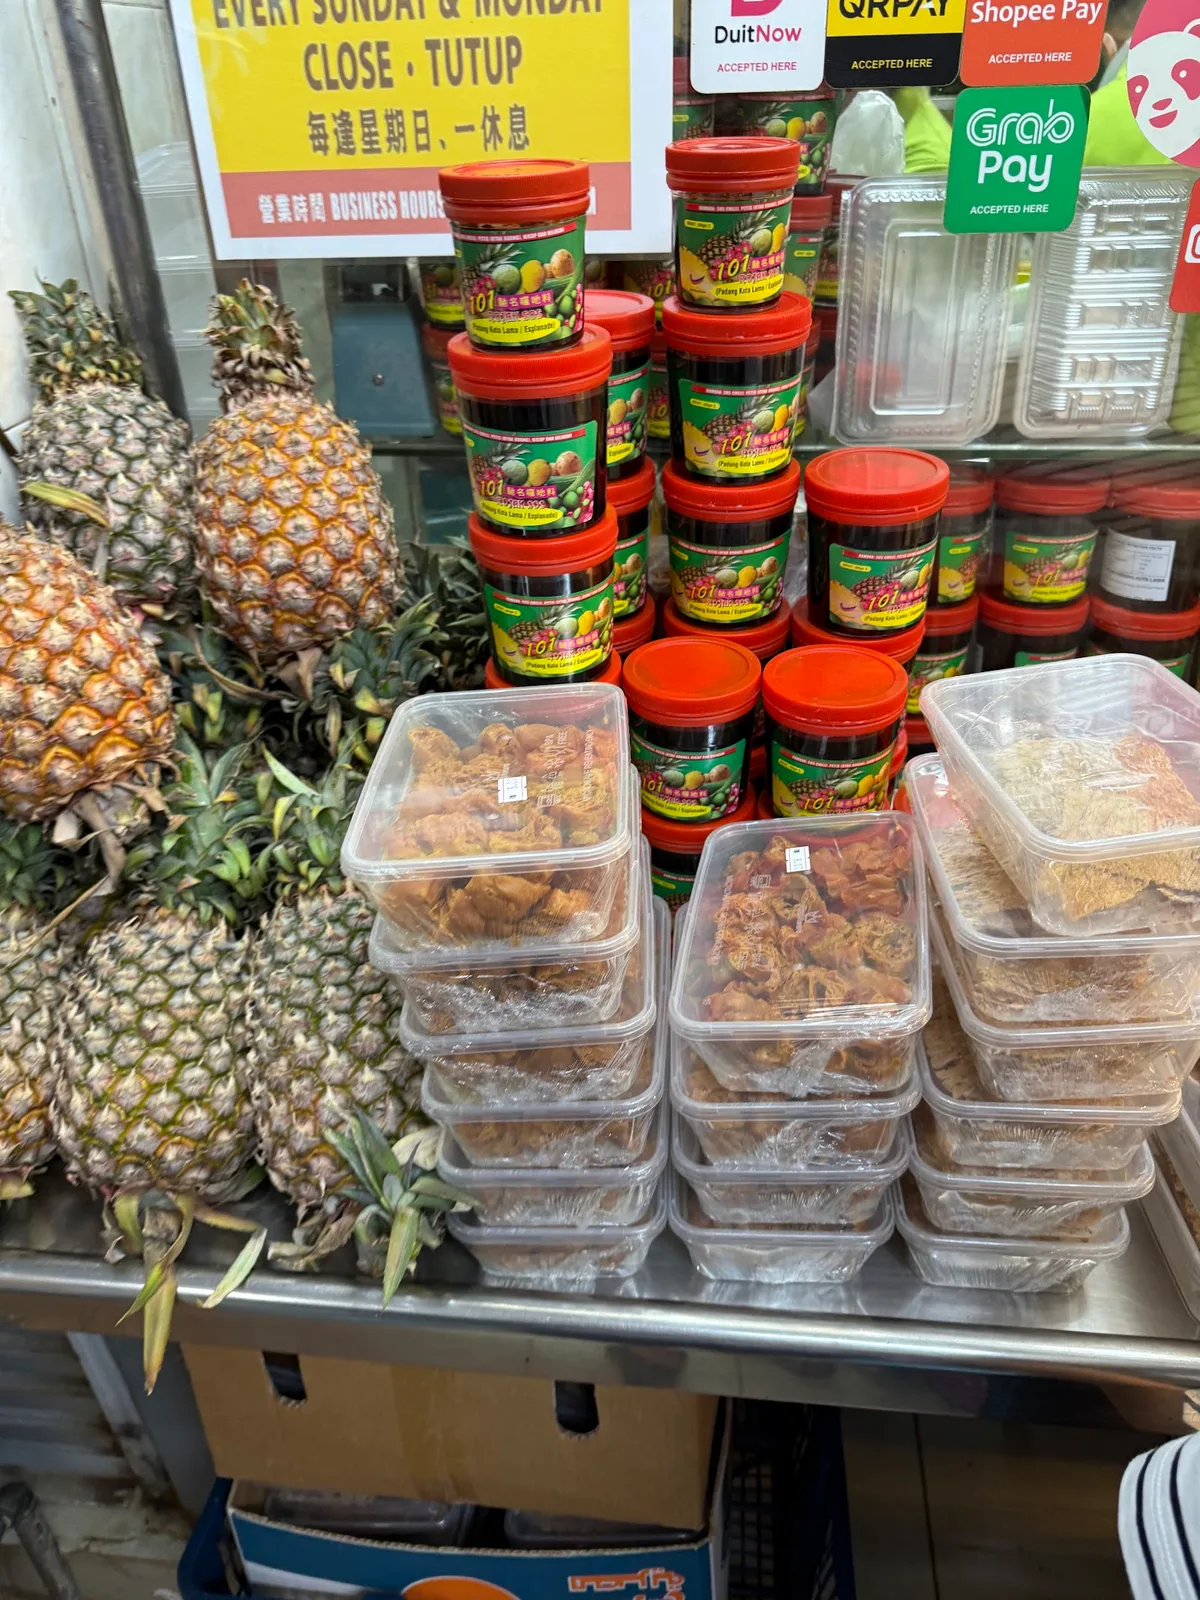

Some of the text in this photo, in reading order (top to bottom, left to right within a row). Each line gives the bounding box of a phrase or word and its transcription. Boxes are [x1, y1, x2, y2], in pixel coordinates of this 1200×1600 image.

[839, 0, 948, 18] QRPAY
[970, 0, 1102, 28] Shopee Pay
[715, 25, 801, 44] DuitNow
[304, 41, 394, 91] CLOSE
[424, 35, 522, 87] TUTUP
[717, 61, 797, 73] ACCEPTED HERE
[851, 59, 933, 70] ACCEPTED HERE
[988, 52, 1072, 64] ACCEPTED HERE
[308, 103, 529, 156] 每逢星期日、一休息
[966, 99, 1075, 147] Grab
[977, 150, 1053, 192] Pay
[329, 191, 397, 221] BUSINESS
[399, 190, 446, 219] HOURS
[970, 204, 1049, 215] ACCEPTED HERE
[718, 254, 749, 280] 101
[468, 290, 495, 315] 101
[722, 431, 752, 455] 101
[480, 479, 504, 497] 101
[691, 584, 716, 599] 101
[869, 590, 899, 611] 101
[527, 637, 556, 657] 101
[804, 796, 834, 811] 101
